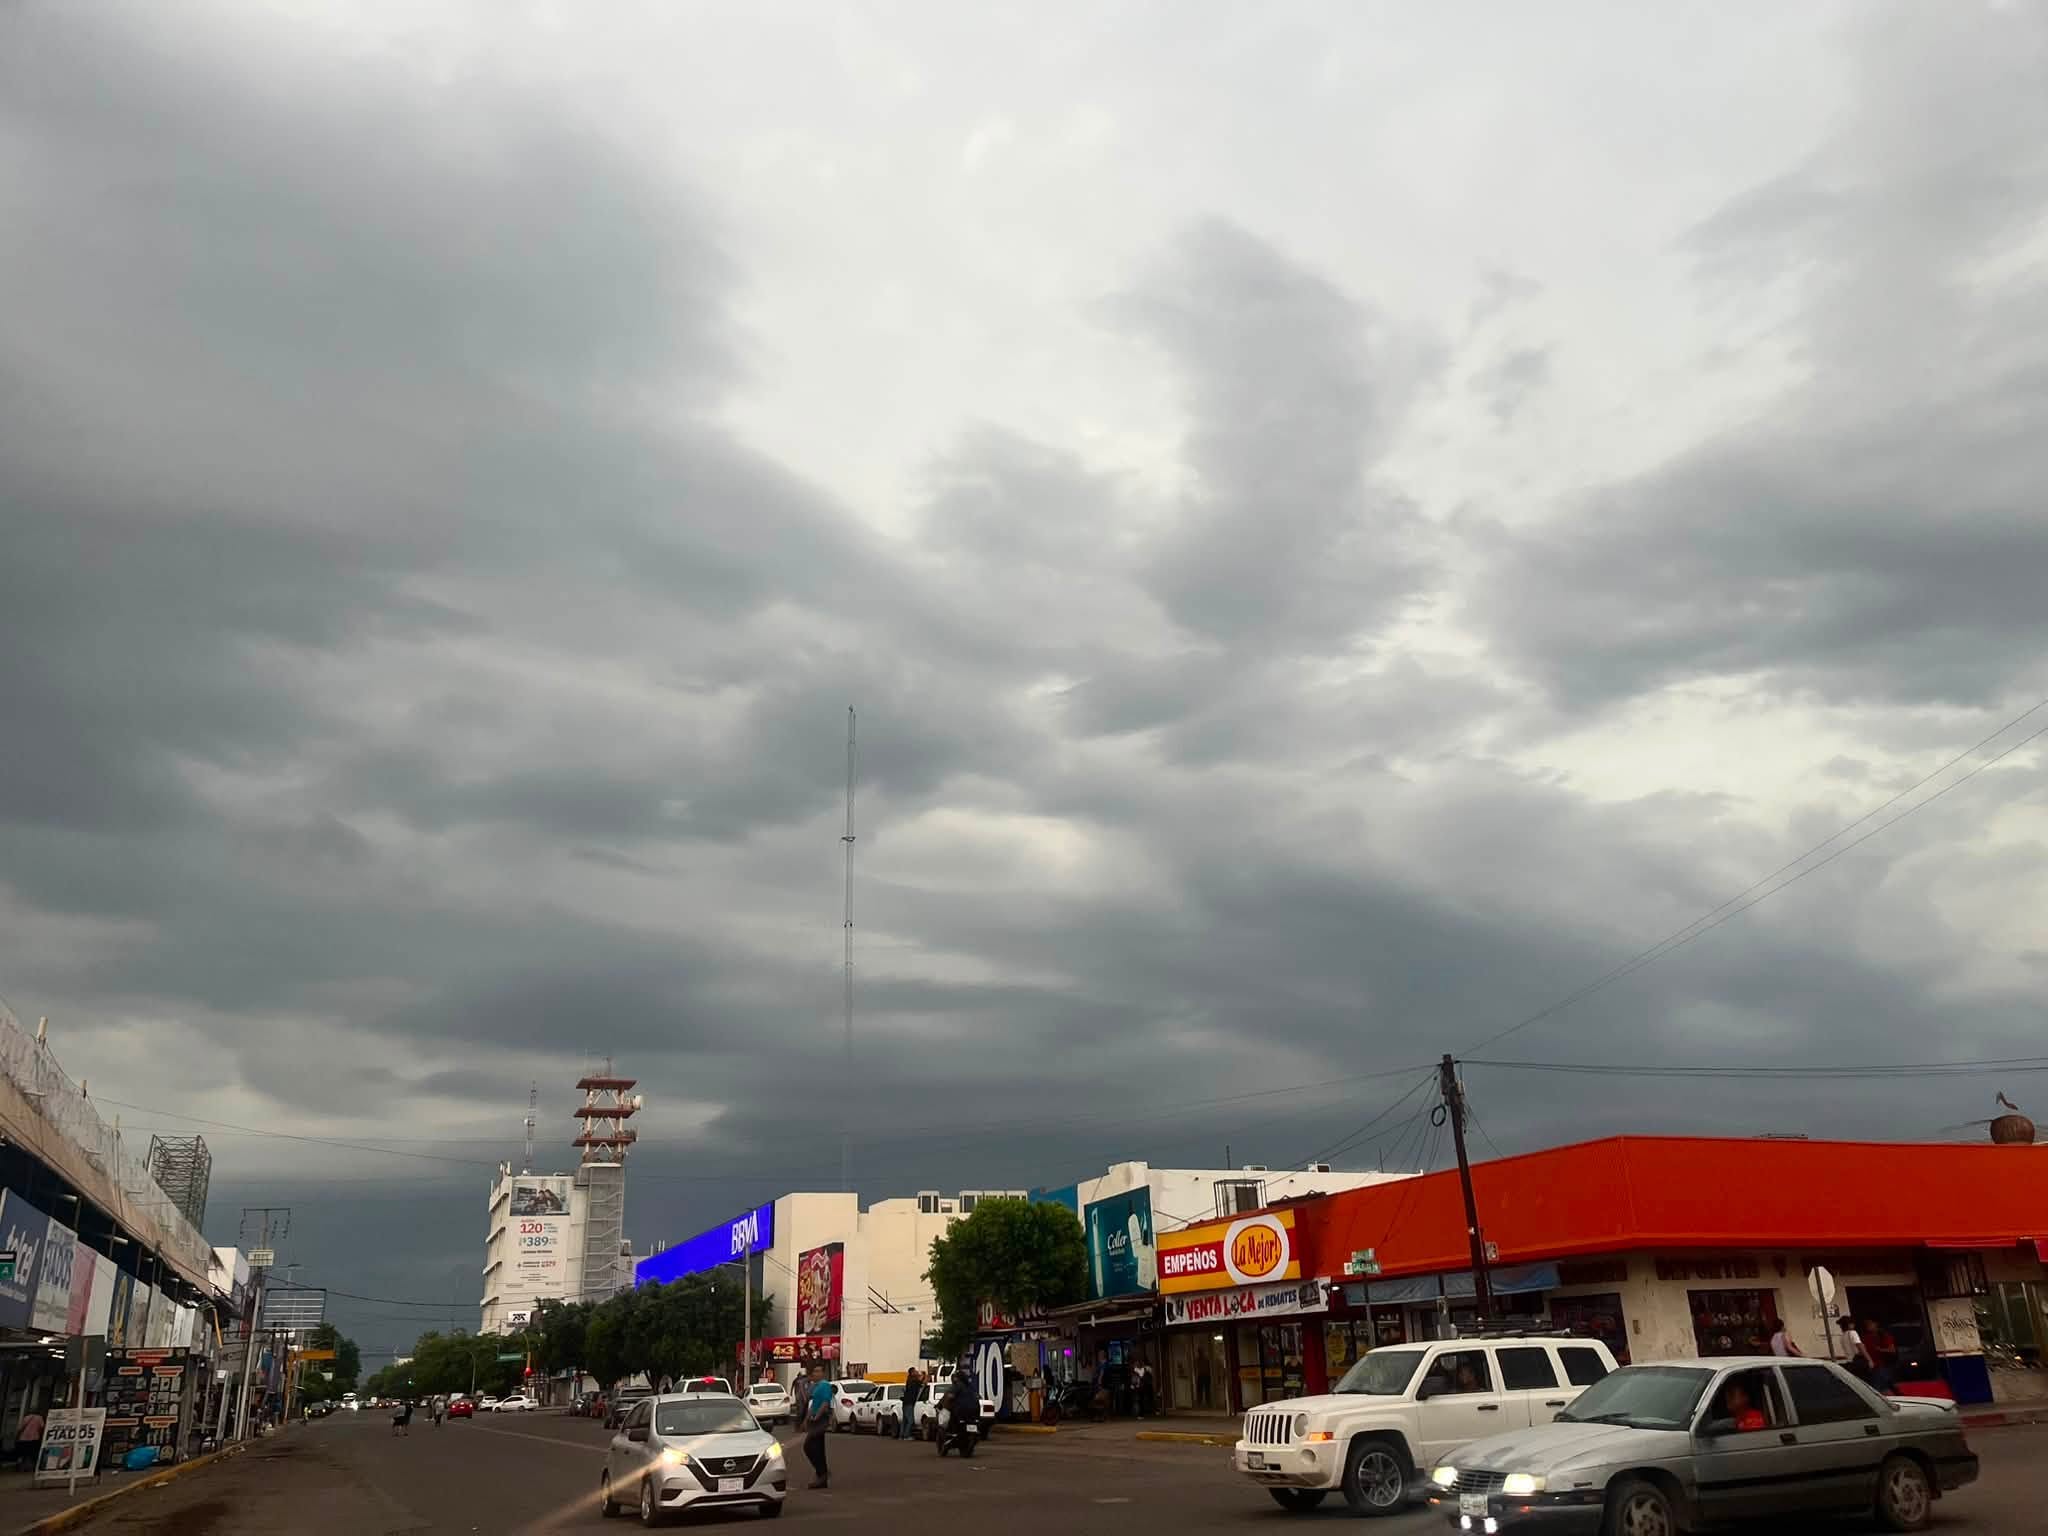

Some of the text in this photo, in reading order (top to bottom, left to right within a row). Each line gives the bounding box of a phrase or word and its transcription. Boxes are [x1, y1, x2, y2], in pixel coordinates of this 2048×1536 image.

[520, 1223, 542, 1234] 120
[731, 1210, 758, 1255] BBVA
[1164, 1247, 1218, 1274] EMPEÑOS
[1234, 1230, 1279, 1272] La Mejor!
[1186, 1295, 1222, 1320] VENTA
[1265, 1289, 1297, 1308] REMATES
[773, 1345, 795, 1356] 4x3
[975, 1341, 1004, 1413] 10
[47, 1427, 96, 1440] FIADOS
